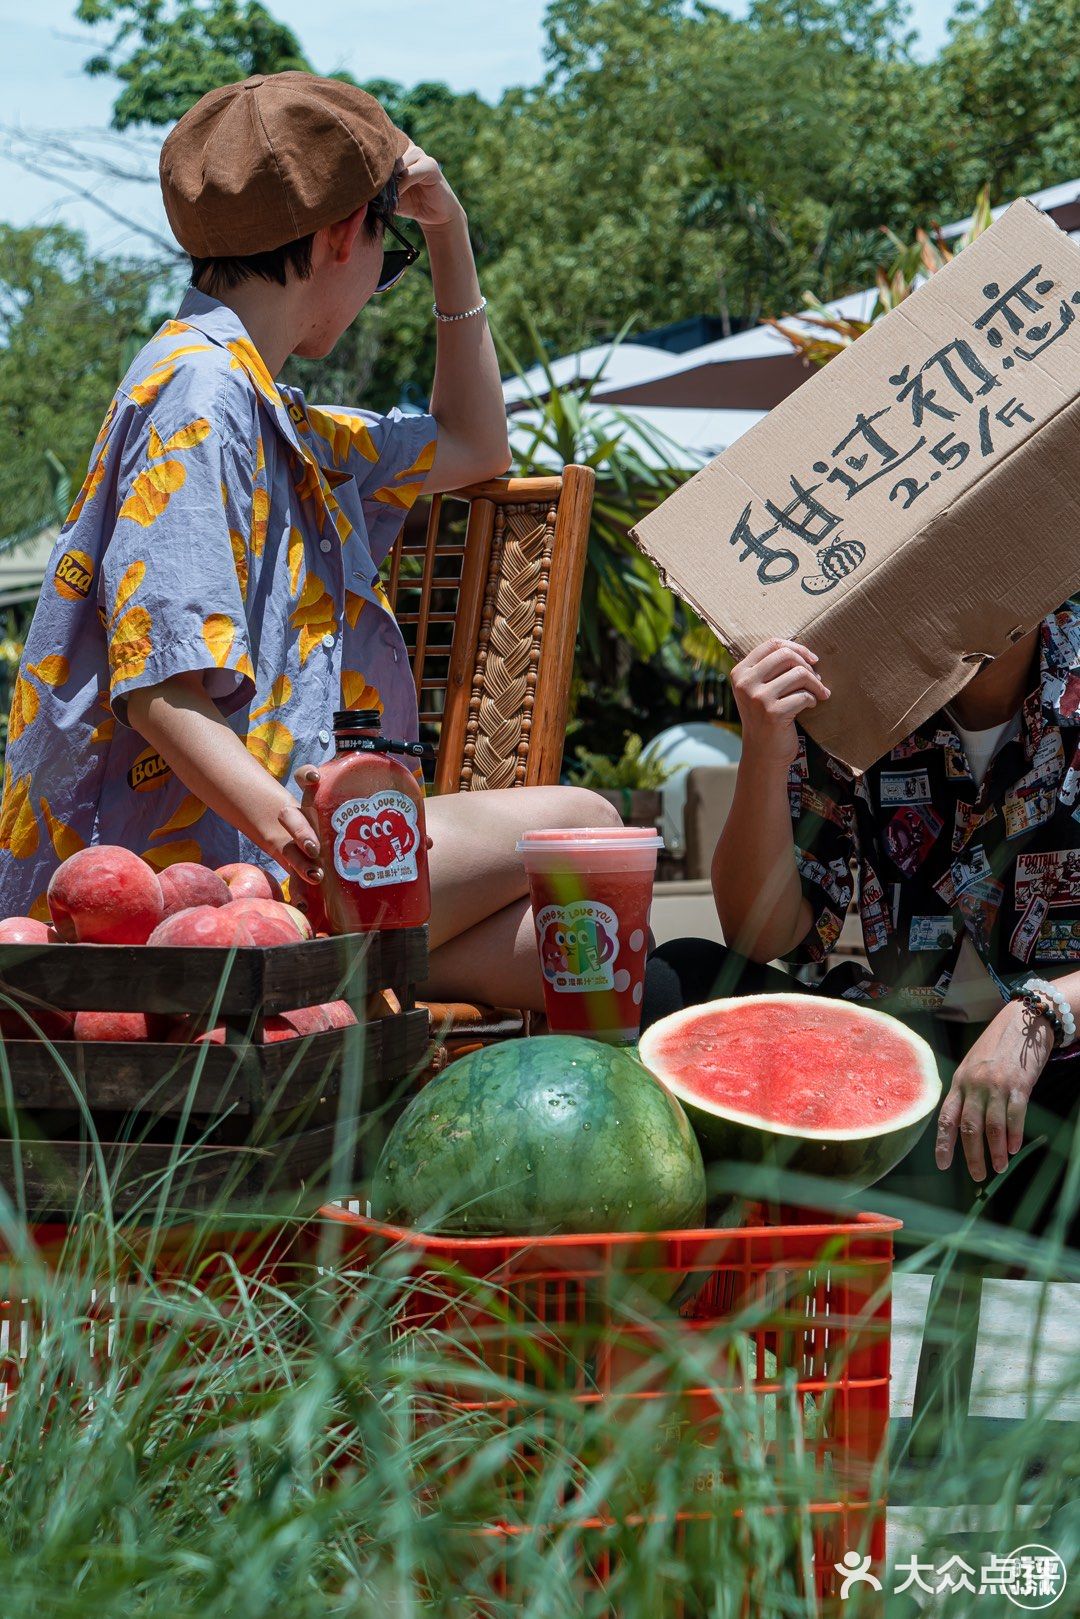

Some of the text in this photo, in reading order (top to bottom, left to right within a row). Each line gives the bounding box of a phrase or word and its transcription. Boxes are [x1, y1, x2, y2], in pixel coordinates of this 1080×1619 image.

[729, 264, 1080, 585] 甜过初恋
[56, 555, 93, 592] Bad
[336, 802, 370, 826] 1000%
[396, 798, 412, 814] YOU
[595, 909, 613, 924] YOU
